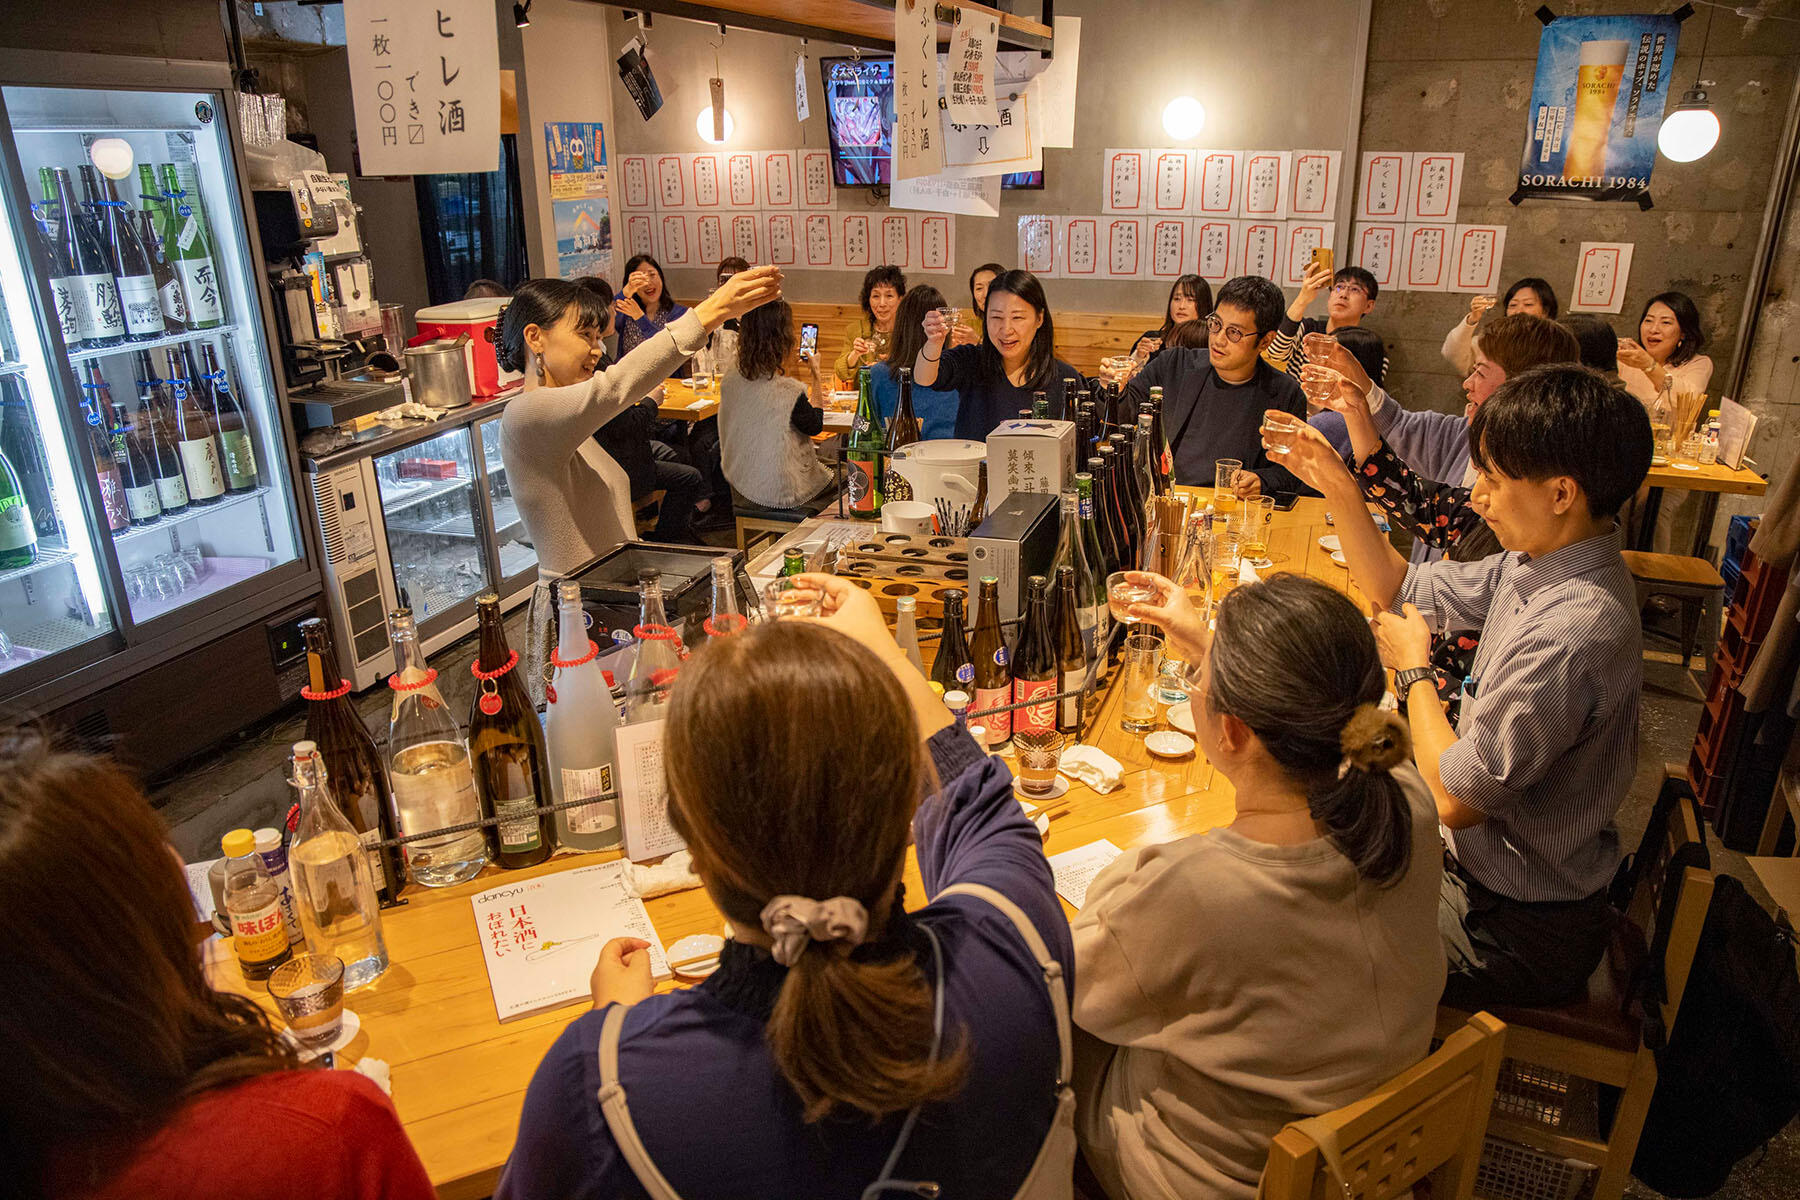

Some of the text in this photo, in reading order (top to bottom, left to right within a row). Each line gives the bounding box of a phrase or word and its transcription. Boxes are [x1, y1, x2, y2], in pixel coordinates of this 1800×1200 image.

[436, 9, 465, 136] ヒレ酒
[919, 7, 930, 151] ふぐヒレ酒
[1647, 34, 1665, 90] 世界が認めた
[1377, 160, 1391, 209] ふぐヒレ酒
[1521, 174, 1647, 190] SORACHI 1984
[193, 264, 218, 308] 而今
[478, 887, 524, 904] dancyu
[487, 912, 511, 958] おぼれたい
[508, 903, 538, 951] 日本酒に
